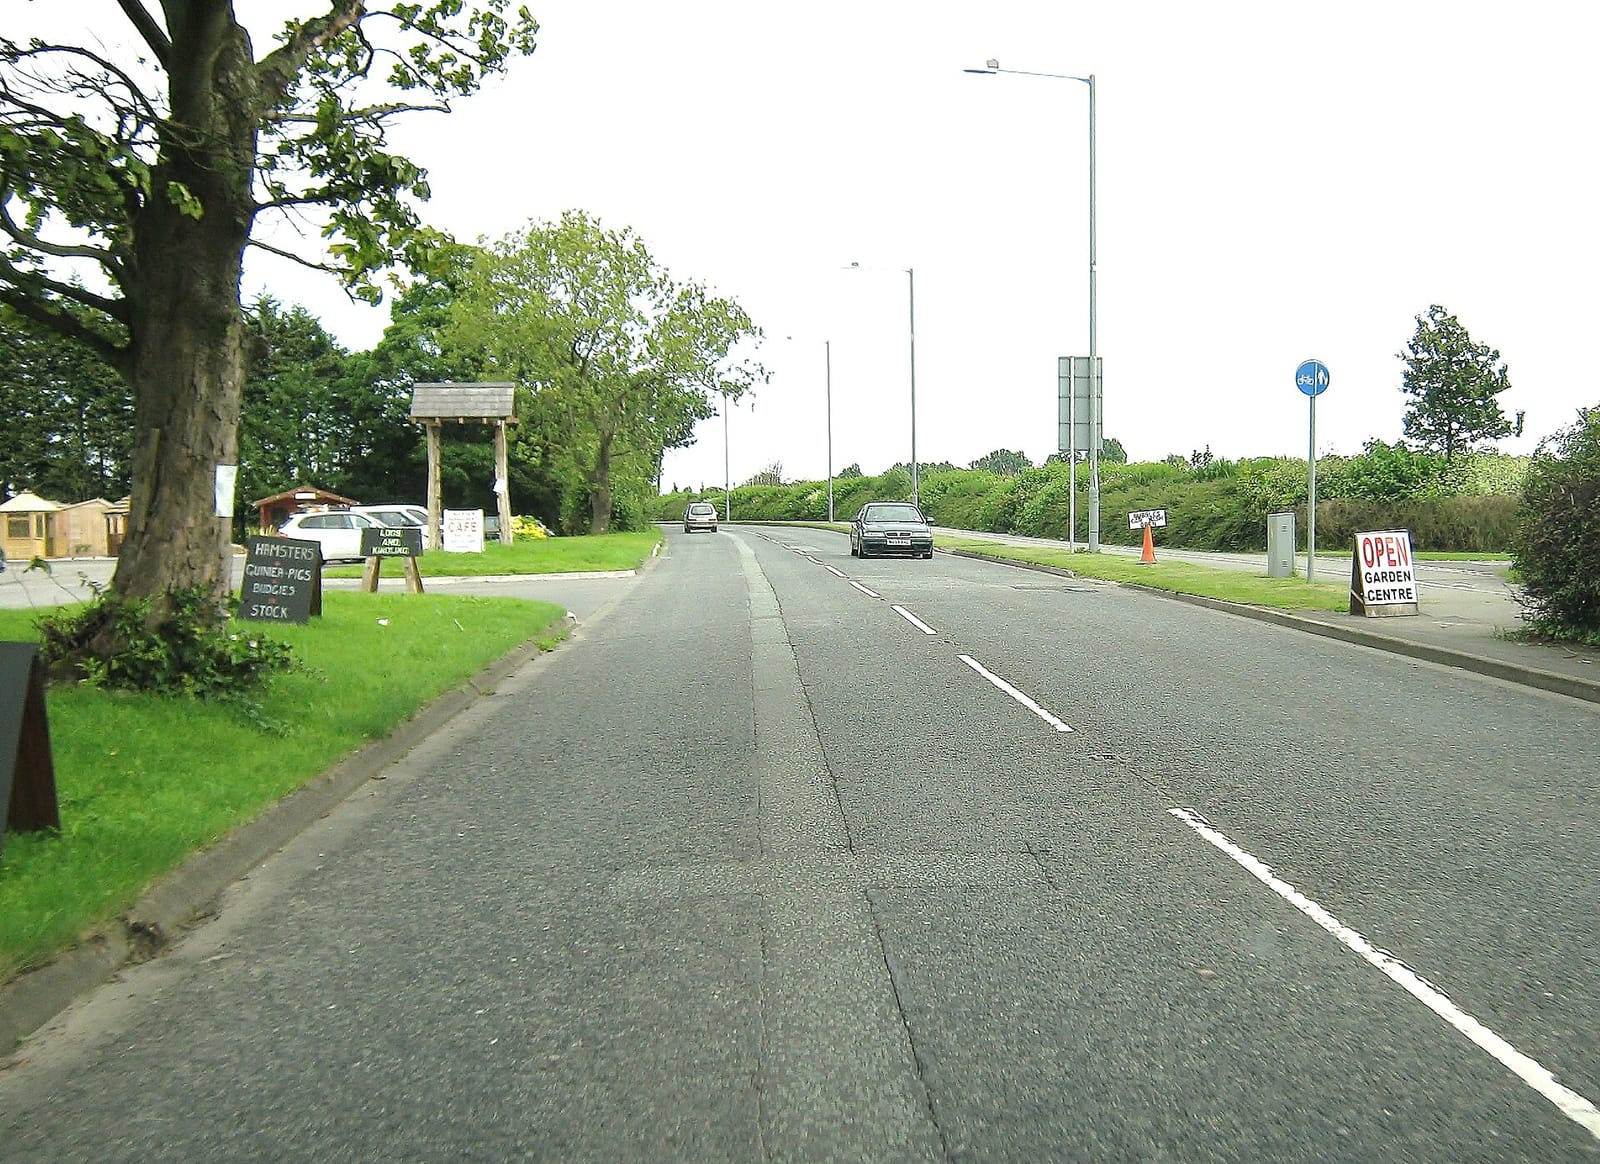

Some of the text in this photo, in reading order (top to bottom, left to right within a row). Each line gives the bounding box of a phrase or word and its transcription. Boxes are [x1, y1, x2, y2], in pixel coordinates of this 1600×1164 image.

[379, 529, 402, 537] LOGS
[448, 521, 477, 533] CAFE
[254, 542, 315, 561] HAMSTERS
[371, 547, 410, 555] KINDLING
[1362, 537, 1409, 568] OPEN
[1364, 570, 1412, 584] GARDEN
[252, 582, 296, 596] BUDGIES
[1367, 588, 1413, 602] CENTRE
[250, 604, 288, 619] STOCK
